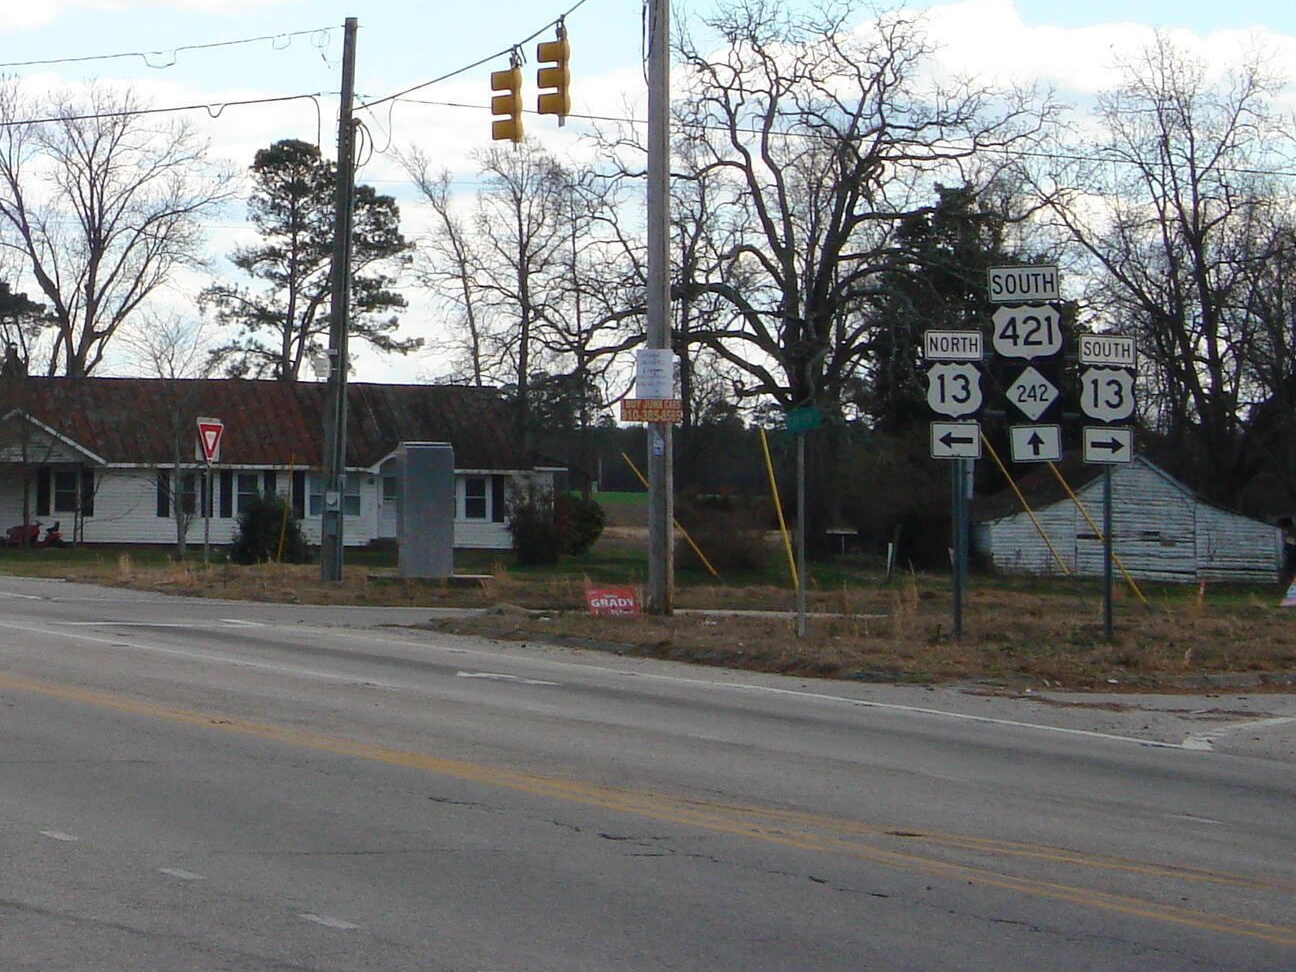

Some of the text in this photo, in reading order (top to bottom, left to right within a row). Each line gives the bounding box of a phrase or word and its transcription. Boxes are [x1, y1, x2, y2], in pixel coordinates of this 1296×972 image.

[992, 273, 1055, 295] SOUTH
[998, 315, 1054, 347] 421
[929, 336, 979, 353] NORTH
[1083, 341, 1131, 358] SOUTH
[937, 373, 972, 404] 13
[1016, 383, 1049, 403] 242
[1091, 378, 1124, 409] 13
[625, 399, 642, 409] BUY
[644, 399, 663, 409] JUNK
[592, 599, 633, 607] GRADY
